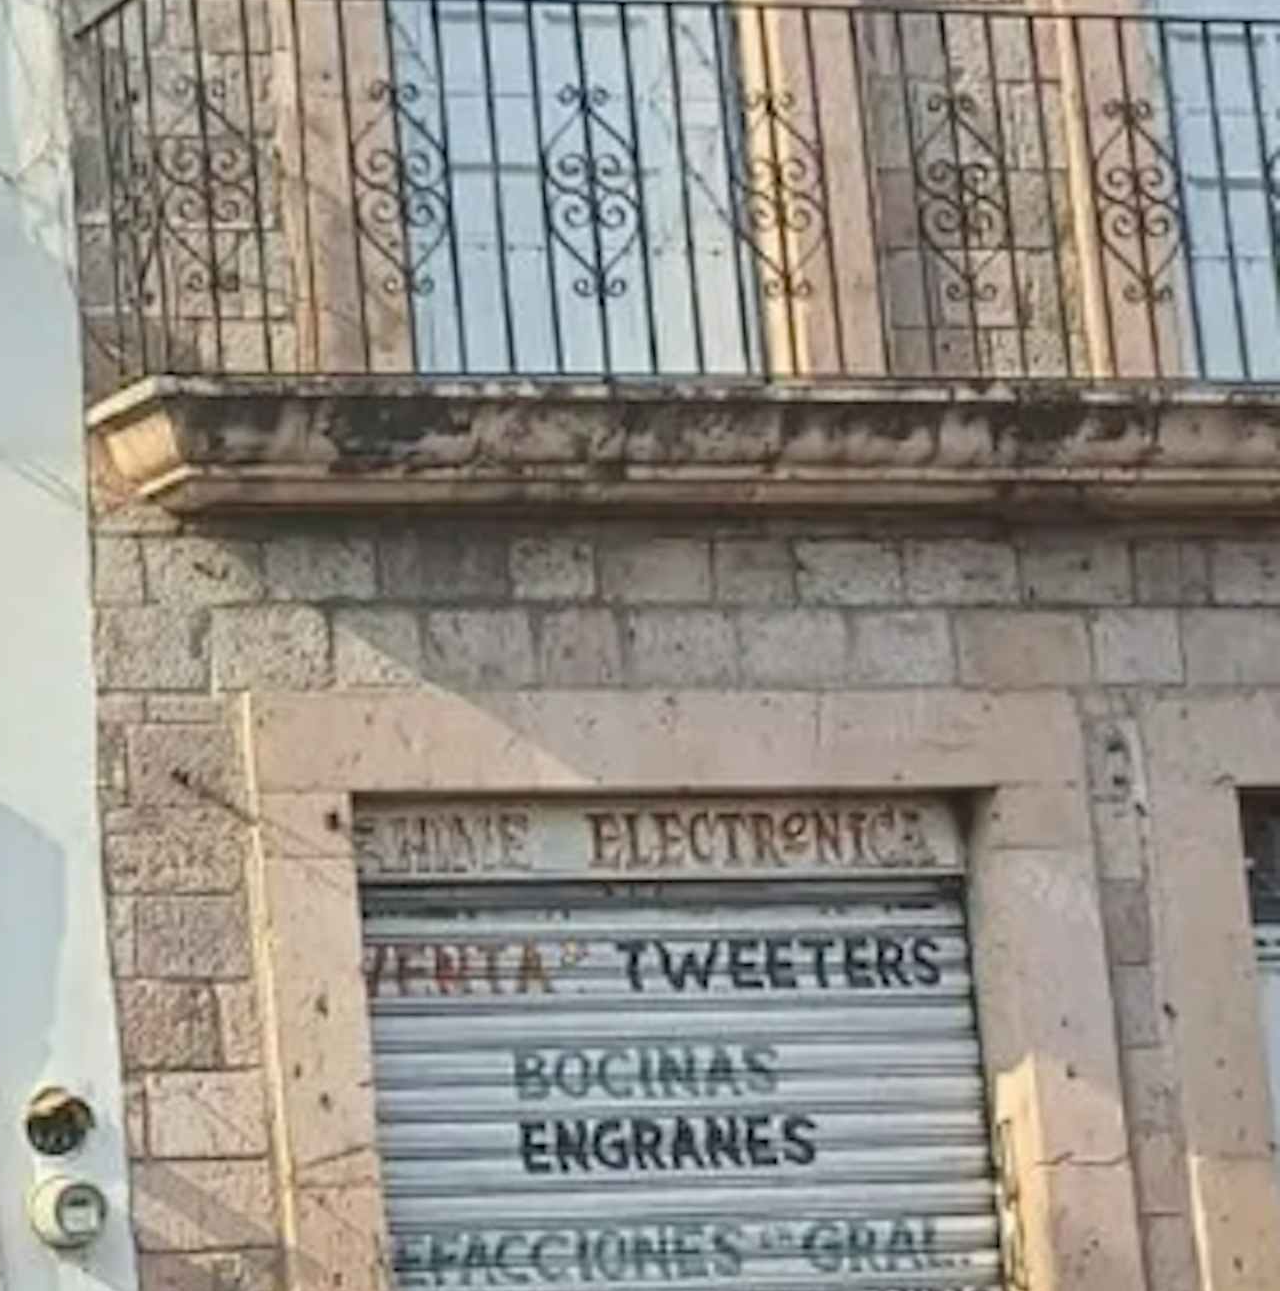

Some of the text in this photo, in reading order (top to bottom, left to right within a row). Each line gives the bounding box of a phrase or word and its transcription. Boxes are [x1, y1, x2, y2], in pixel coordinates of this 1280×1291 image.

[615, 936, 941, 992] TWEETERS
[513, 1044, 778, 1101] BOCINAS
[519, 1114, 817, 1174] ENGRANES
